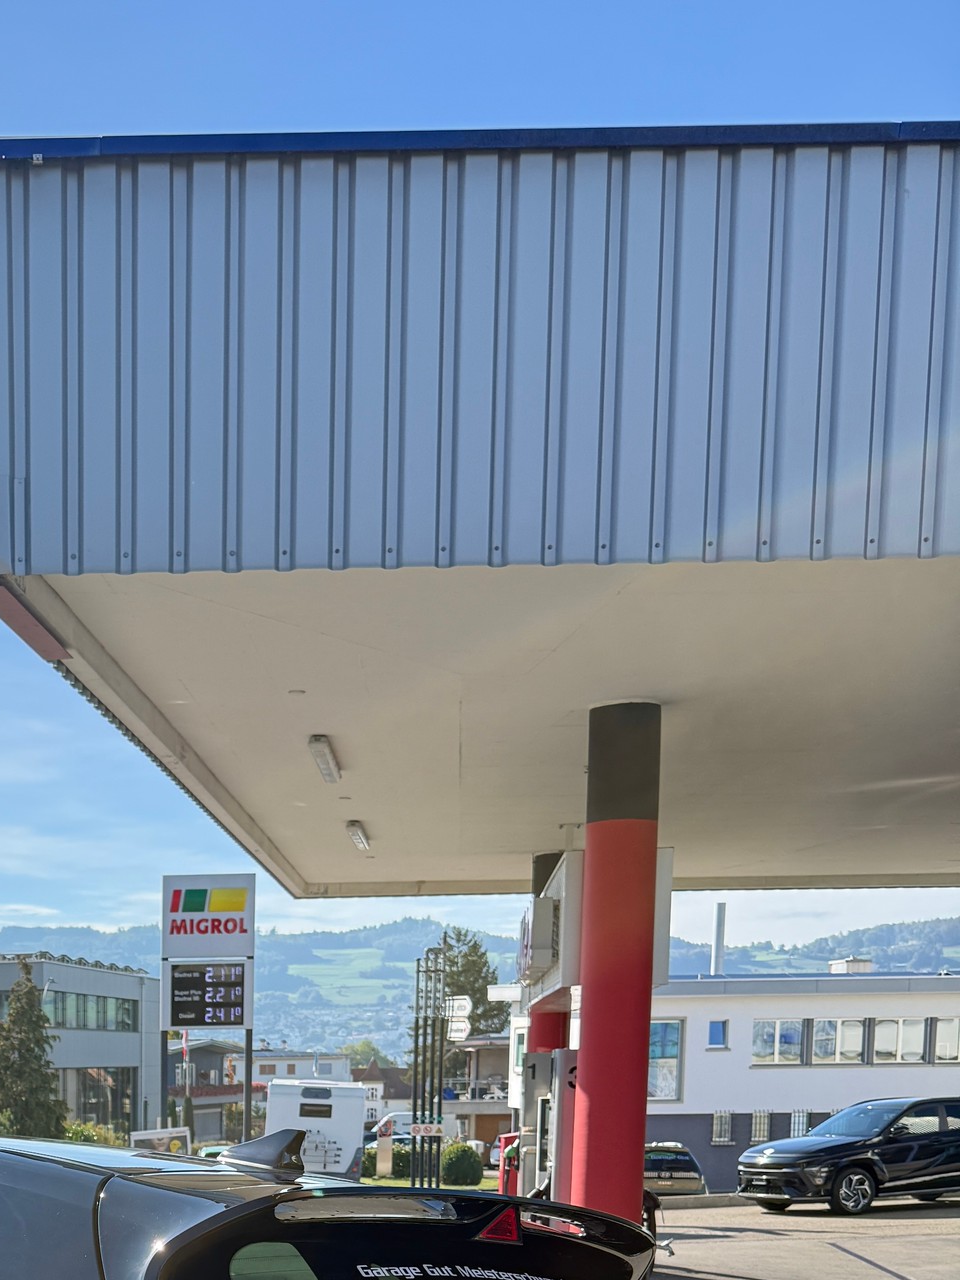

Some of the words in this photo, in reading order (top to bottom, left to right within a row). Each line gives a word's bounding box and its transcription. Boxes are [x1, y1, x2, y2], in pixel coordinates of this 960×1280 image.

[169, 917, 248, 935] MIGROL
[527, 1063, 536, 1080] 1
[356, 1264, 423, 1279] Garage
[422, 1264, 457, 1277] Gut
